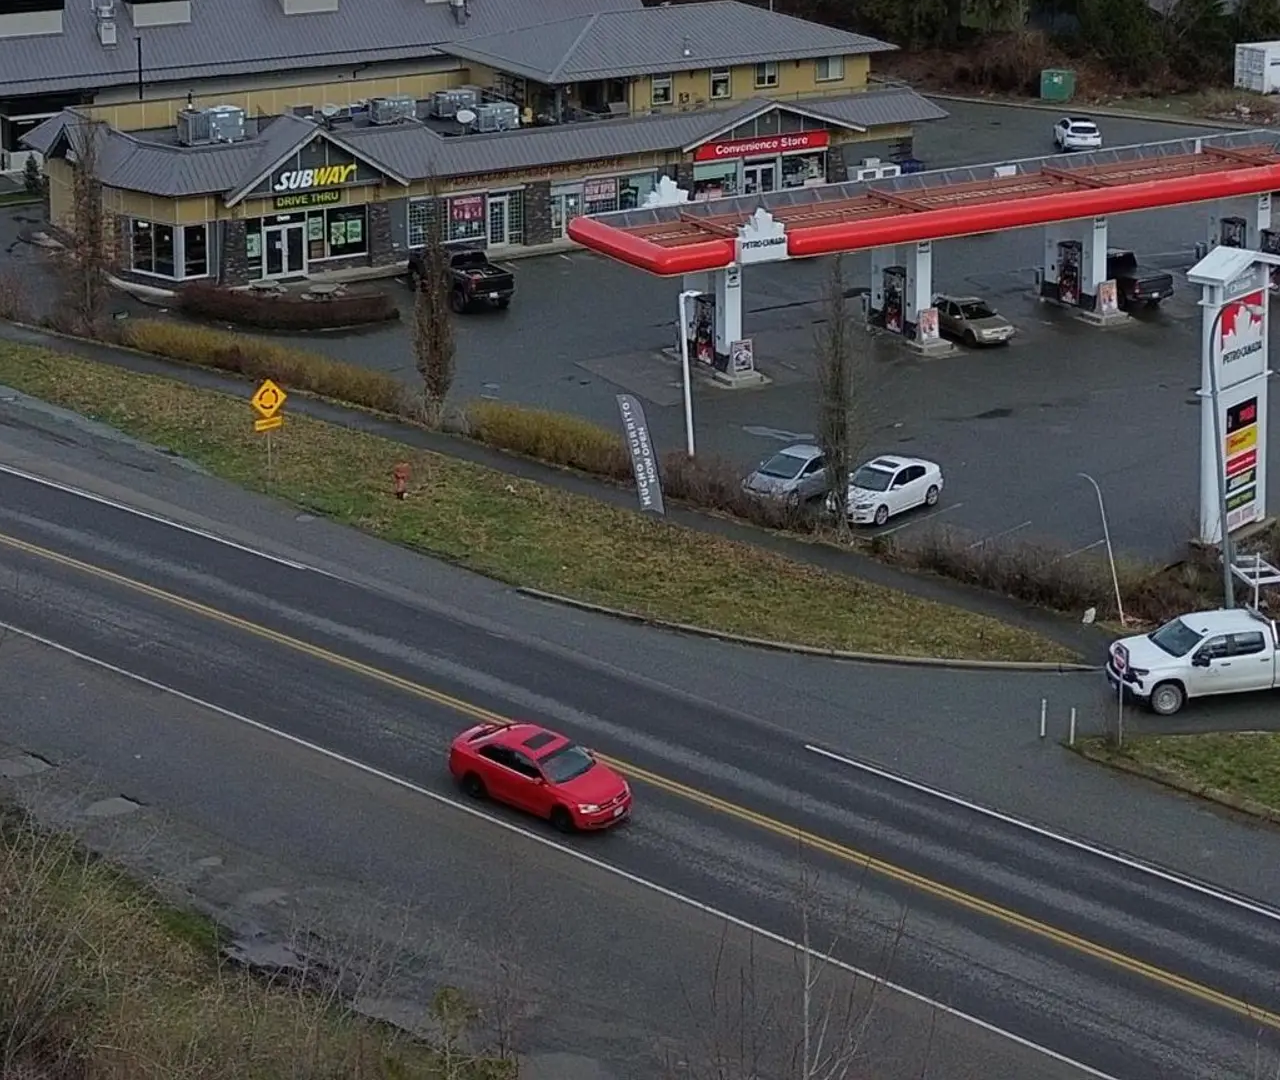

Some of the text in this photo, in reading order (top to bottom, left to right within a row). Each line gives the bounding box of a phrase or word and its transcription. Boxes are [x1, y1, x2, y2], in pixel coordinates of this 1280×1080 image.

[715, 136, 809, 155] Convenience Store
[274, 164, 358, 191] SUBWAY
[276, 191, 339, 208] DRIVE THRU
[622, 402, 652, 506] MUCHO BURRITO
[637, 427, 656, 483] NOW OPEN
